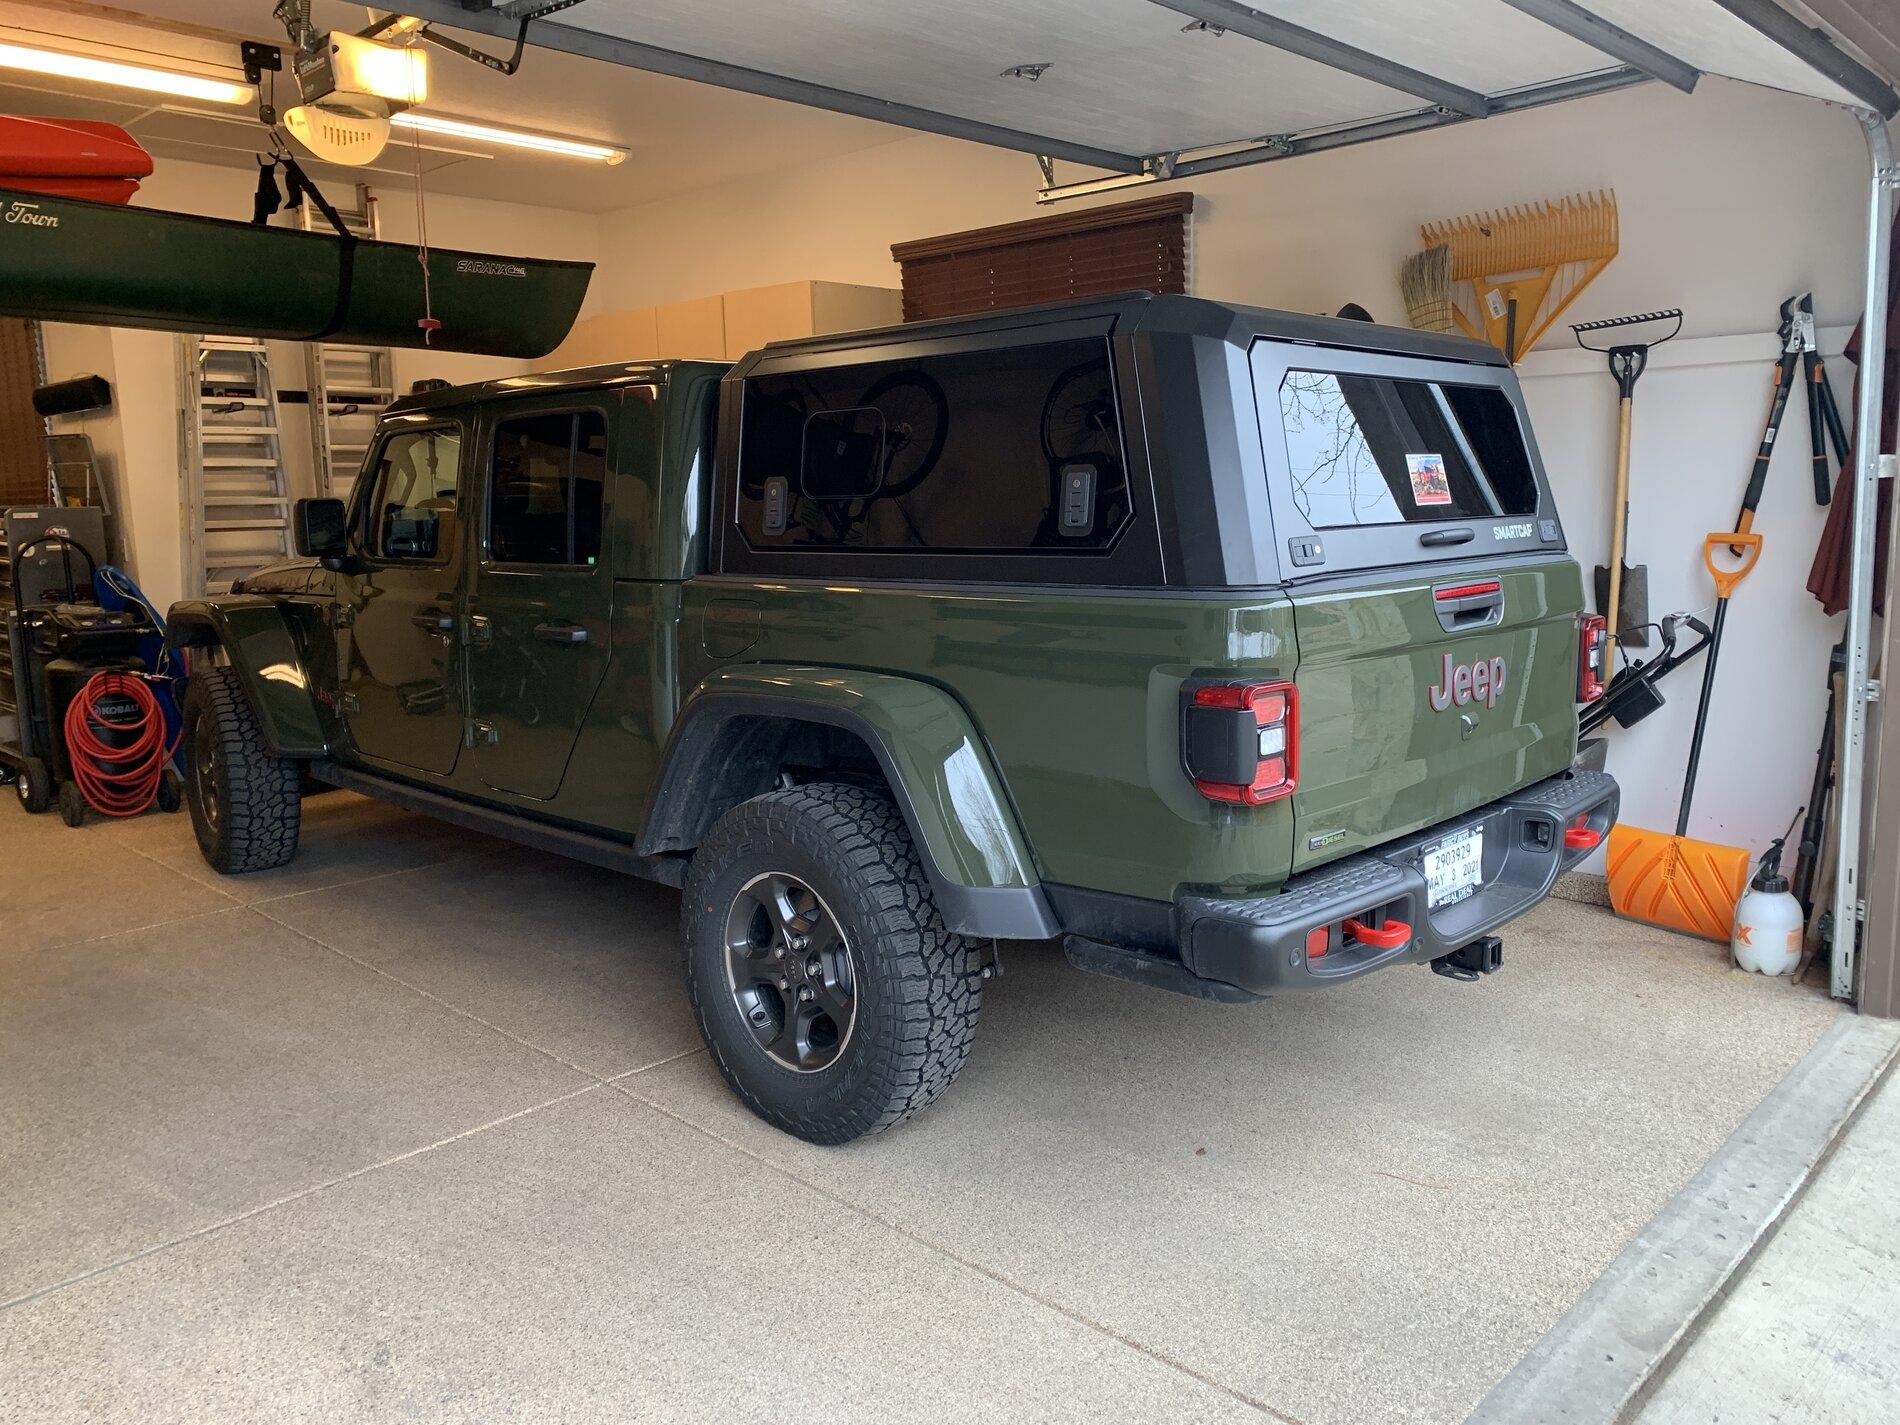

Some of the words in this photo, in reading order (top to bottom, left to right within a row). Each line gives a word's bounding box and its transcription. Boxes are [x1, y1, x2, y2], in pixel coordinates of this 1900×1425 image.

[5, 201, 59, 227] Town
[457, 260, 520, 276] SARANAC
[1493, 523, 1533, 540] SMARTCAP
[1429, 653, 1507, 712] Jeep
[101, 704, 140, 715] KOBALT
[1435, 843, 1471, 871] 2903929
[1463, 859, 1479, 876] 2021
